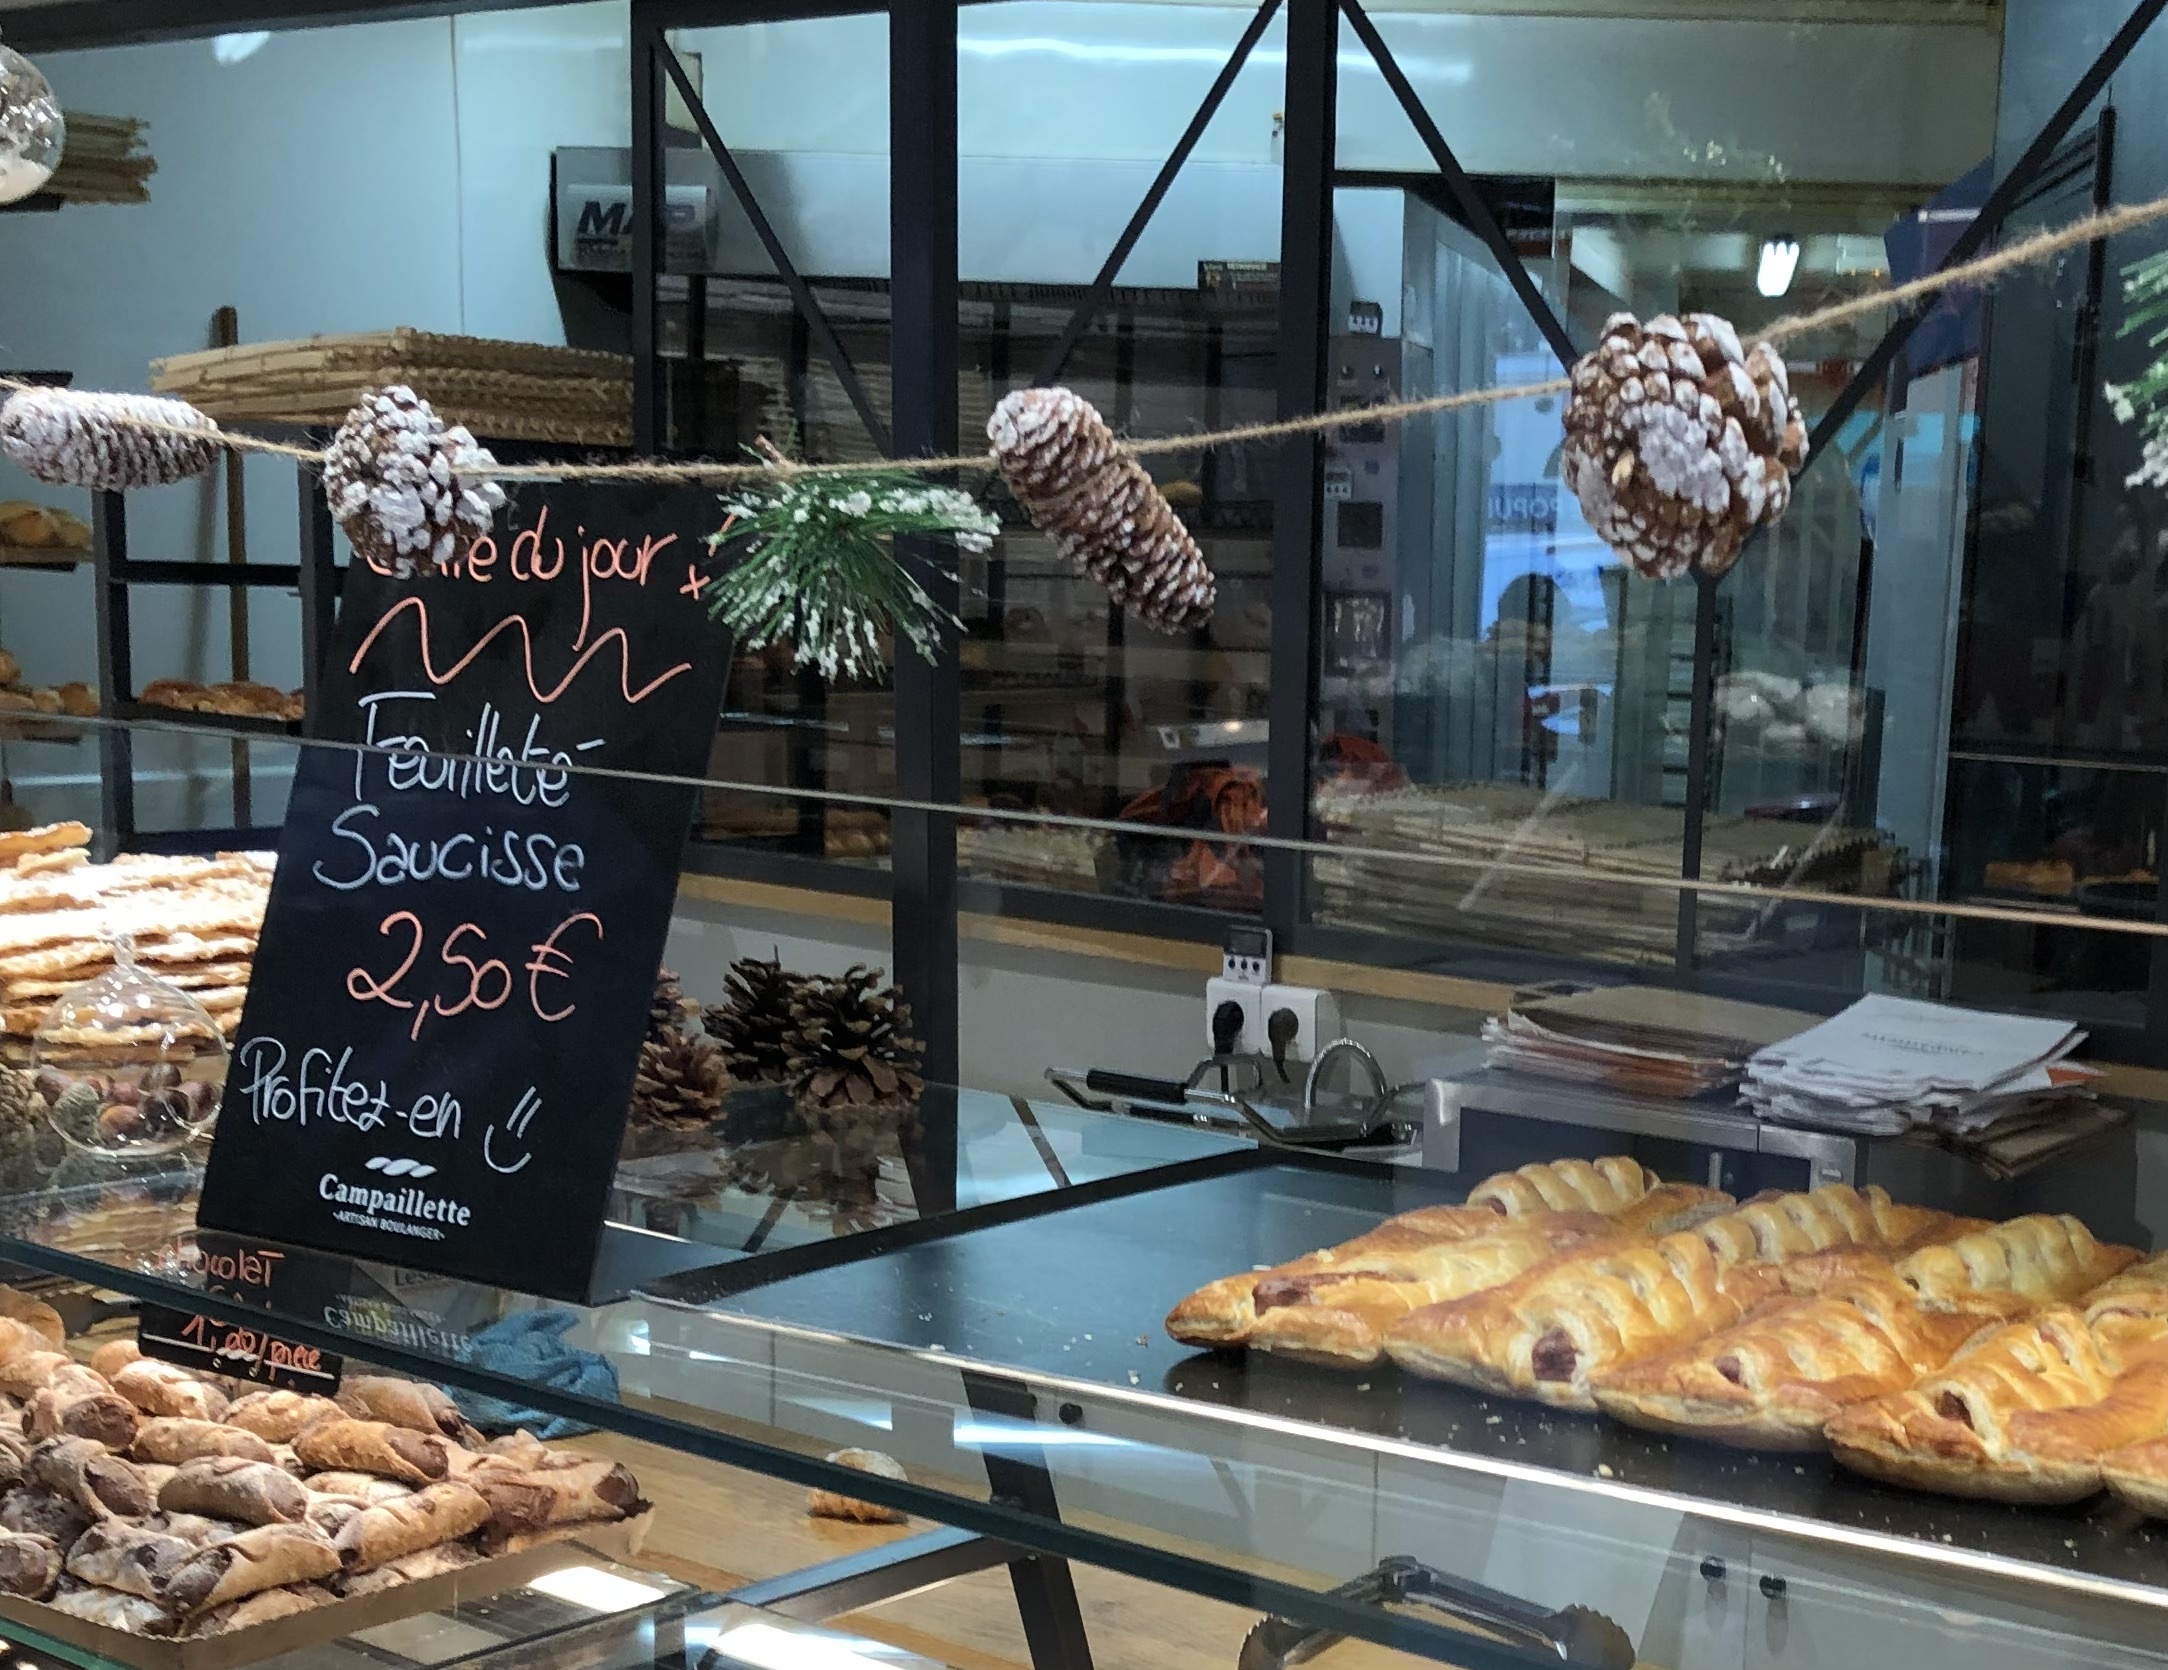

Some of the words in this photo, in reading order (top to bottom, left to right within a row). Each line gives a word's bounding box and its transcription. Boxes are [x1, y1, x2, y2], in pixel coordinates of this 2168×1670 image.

[577, 200, 696, 235] MP
[510, 504, 566, 582] du
[572, 524, 678, 652] jour
[355, 690, 606, 807] Feuilleté
[312, 803, 586, 891] Saucisse
[318, 1172, 472, 1226] Campaillette
